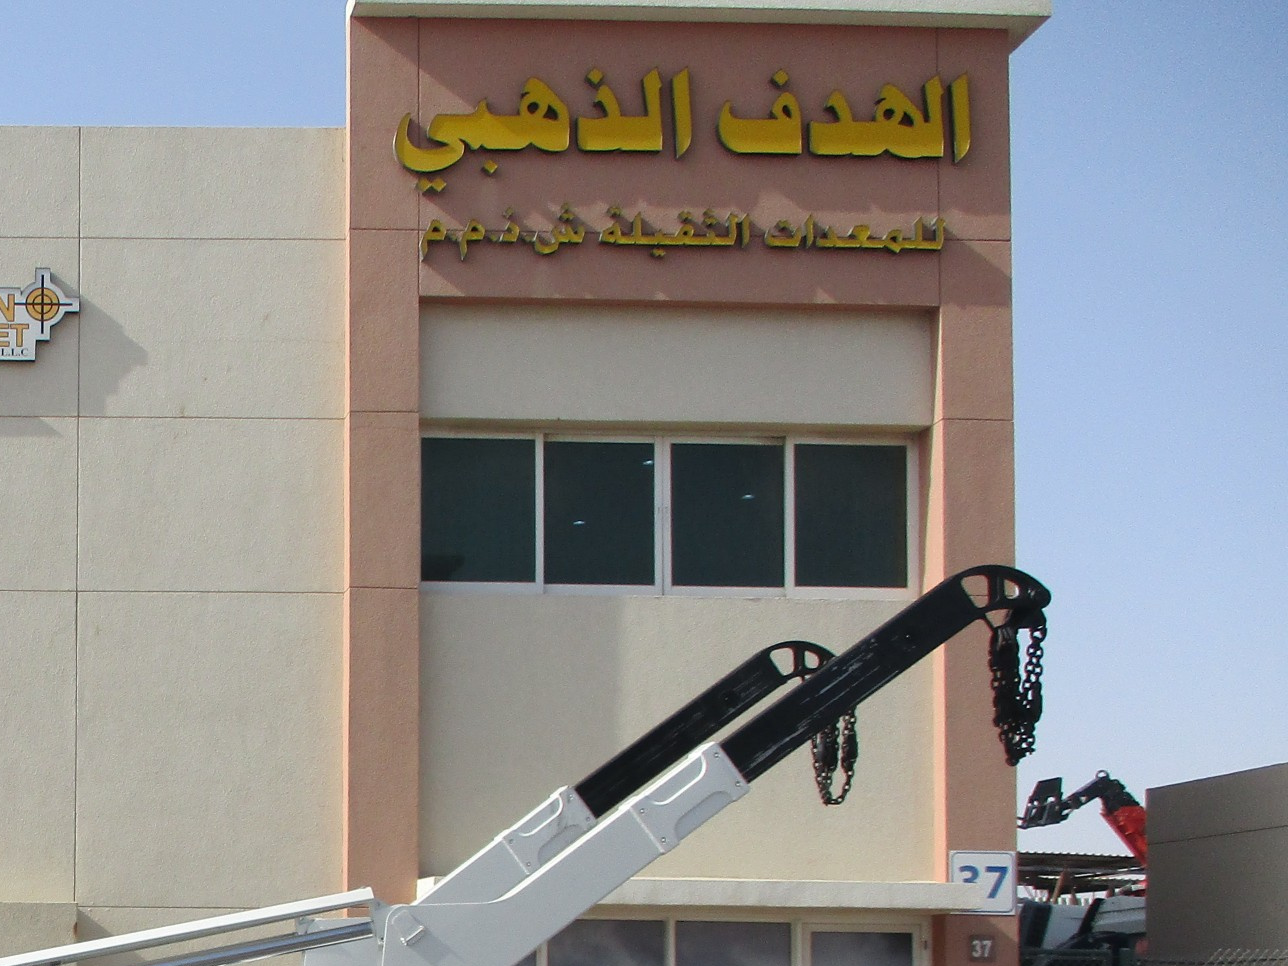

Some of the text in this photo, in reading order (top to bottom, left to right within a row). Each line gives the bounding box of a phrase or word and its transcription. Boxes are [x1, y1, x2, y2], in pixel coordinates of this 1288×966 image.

[393, 66, 971, 193] الهدف الذهبي
[598, 206, 750, 258] الثقيلة
[763, 213, 946, 252] للمعدات
[972, 940, 992, 958] 37
